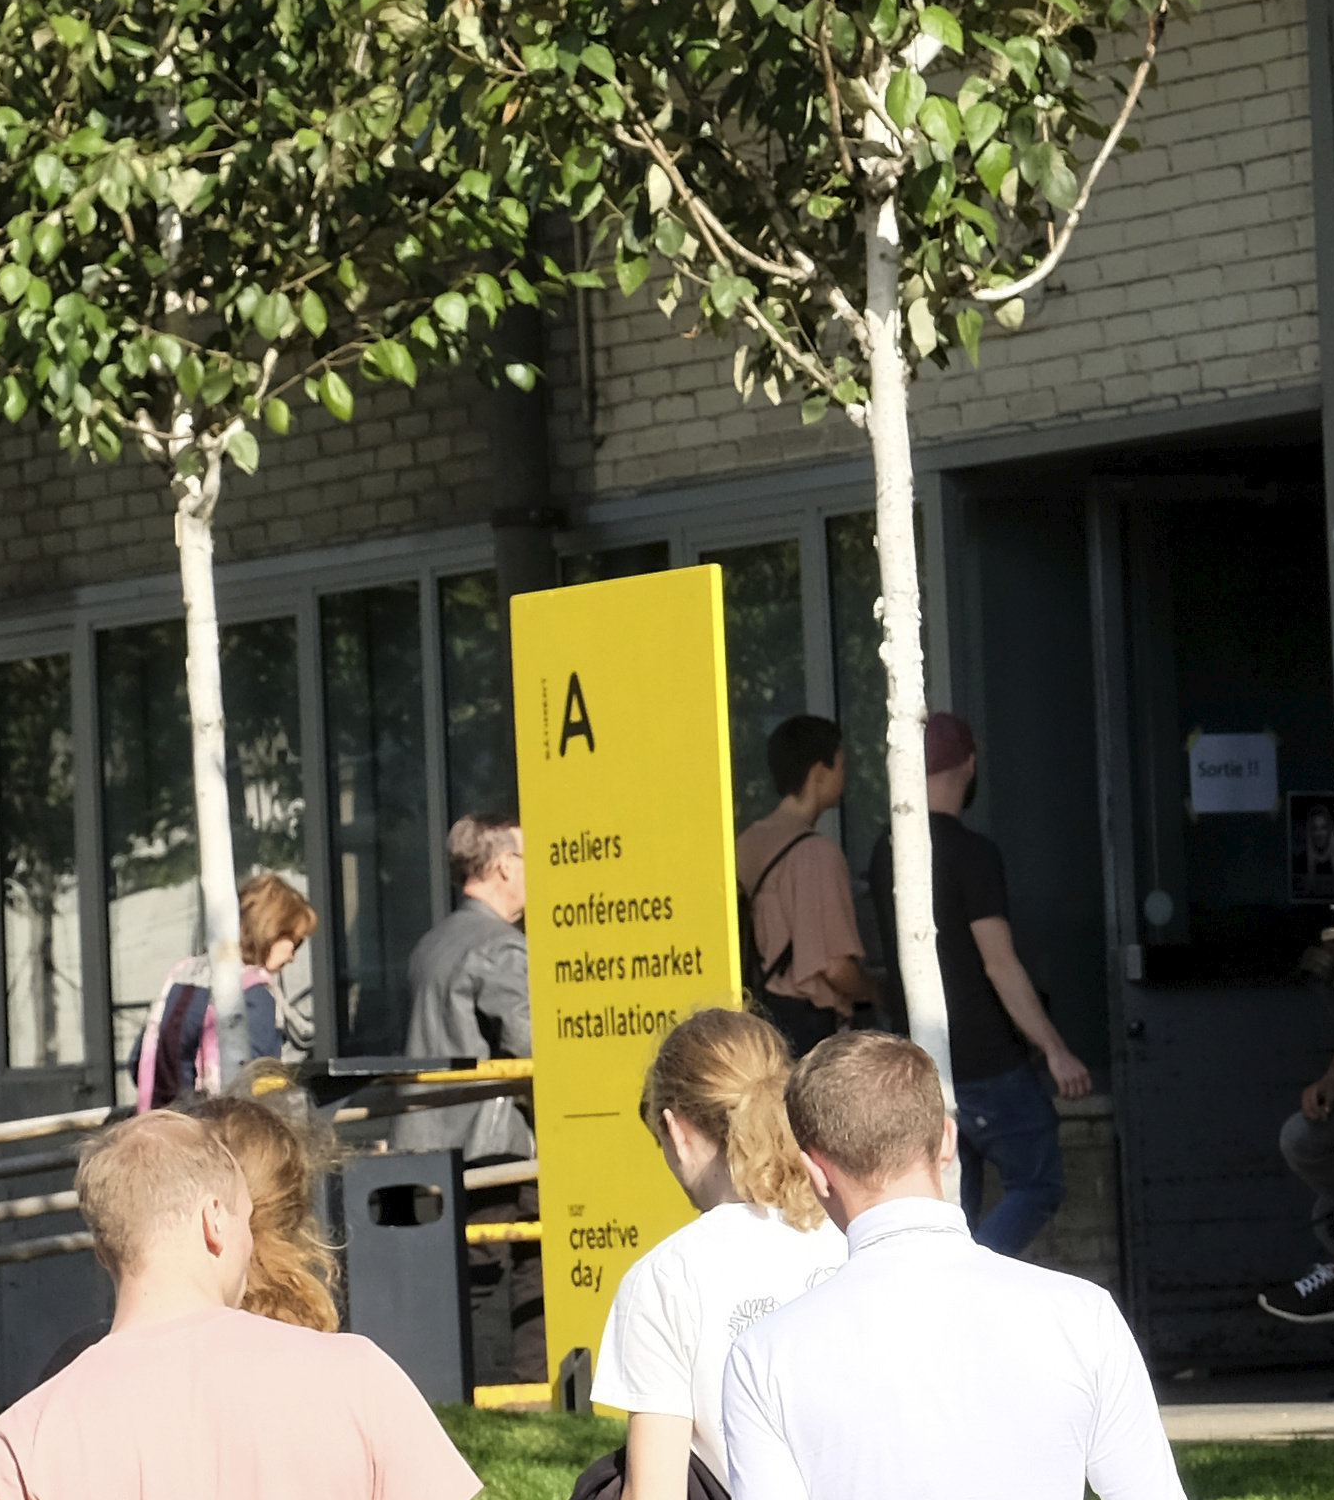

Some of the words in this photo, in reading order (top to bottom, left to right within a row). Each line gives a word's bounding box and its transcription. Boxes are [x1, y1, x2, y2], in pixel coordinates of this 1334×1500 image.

[558, 670, 596, 758] A
[1197, 760, 1244, 779] Sortie
[549, 831, 622, 866] ateliers
[552, 891, 673, 927] conférences
[555, 951, 626, 985] makers
[631, 946, 703, 979] market
[557, 1007, 677, 1041] installations
[569, 1218, 638, 1250] creative
[571, 1259, 602, 1294] day
